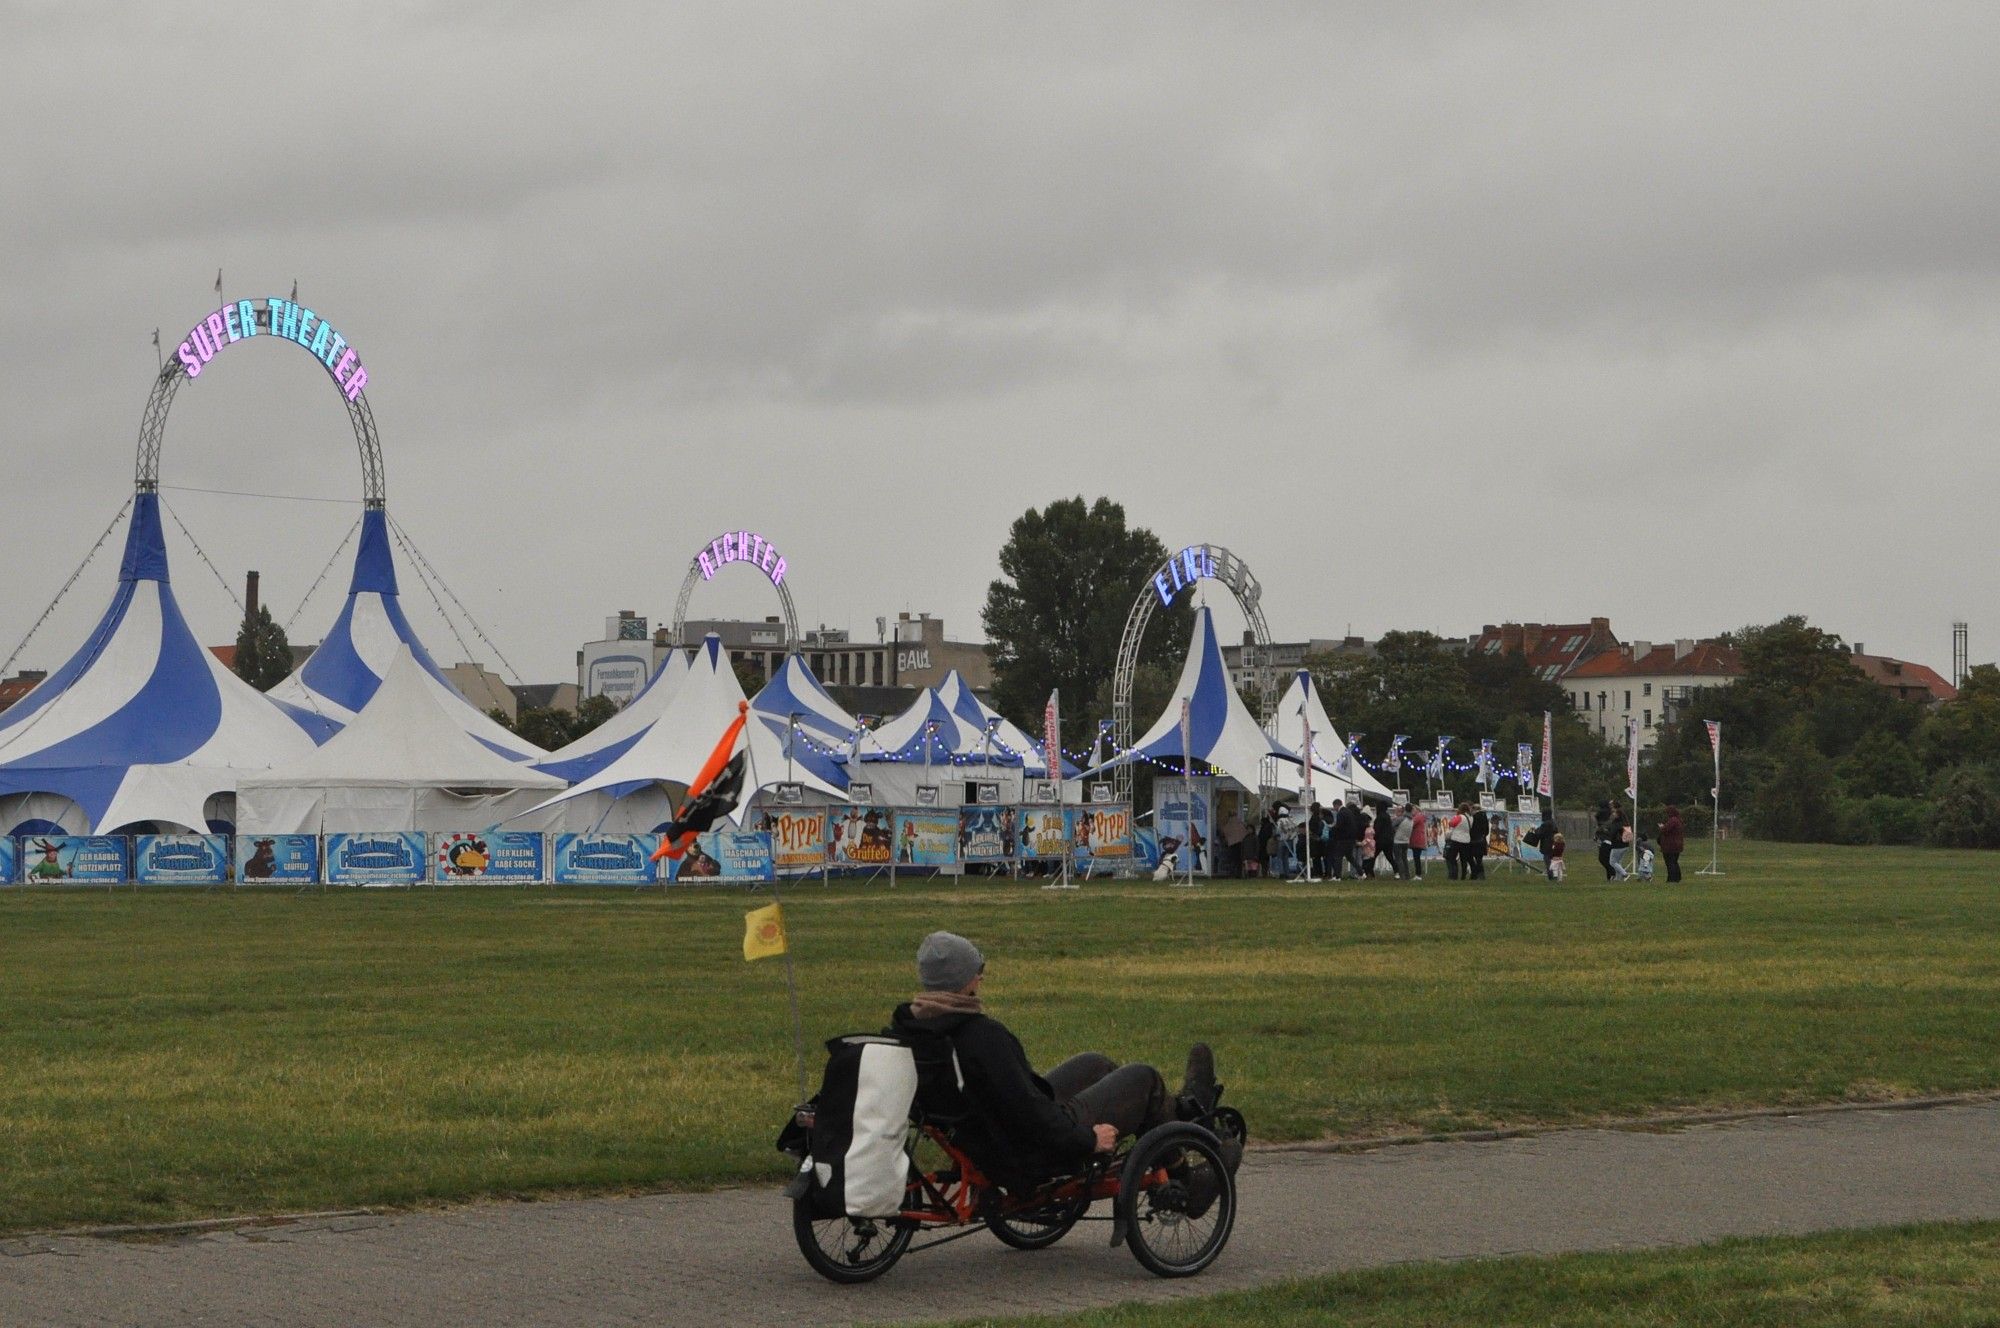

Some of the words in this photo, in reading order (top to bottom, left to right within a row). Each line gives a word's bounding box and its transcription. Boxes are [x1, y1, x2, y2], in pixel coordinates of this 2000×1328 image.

[178, 300, 256, 378] SUPER
[267, 298, 368, 401] THEATER
[699, 531, 786, 585] RICHTER
[780, 814, 824, 850] PIPPI
[1095, 811, 1129, 844] PIPPI
[497, 849, 510, 857] DER
[511, 849, 534, 857] KLEINE
[514, 860, 536, 868] SOCKE
[724, 849, 753, 857] MASCHA
